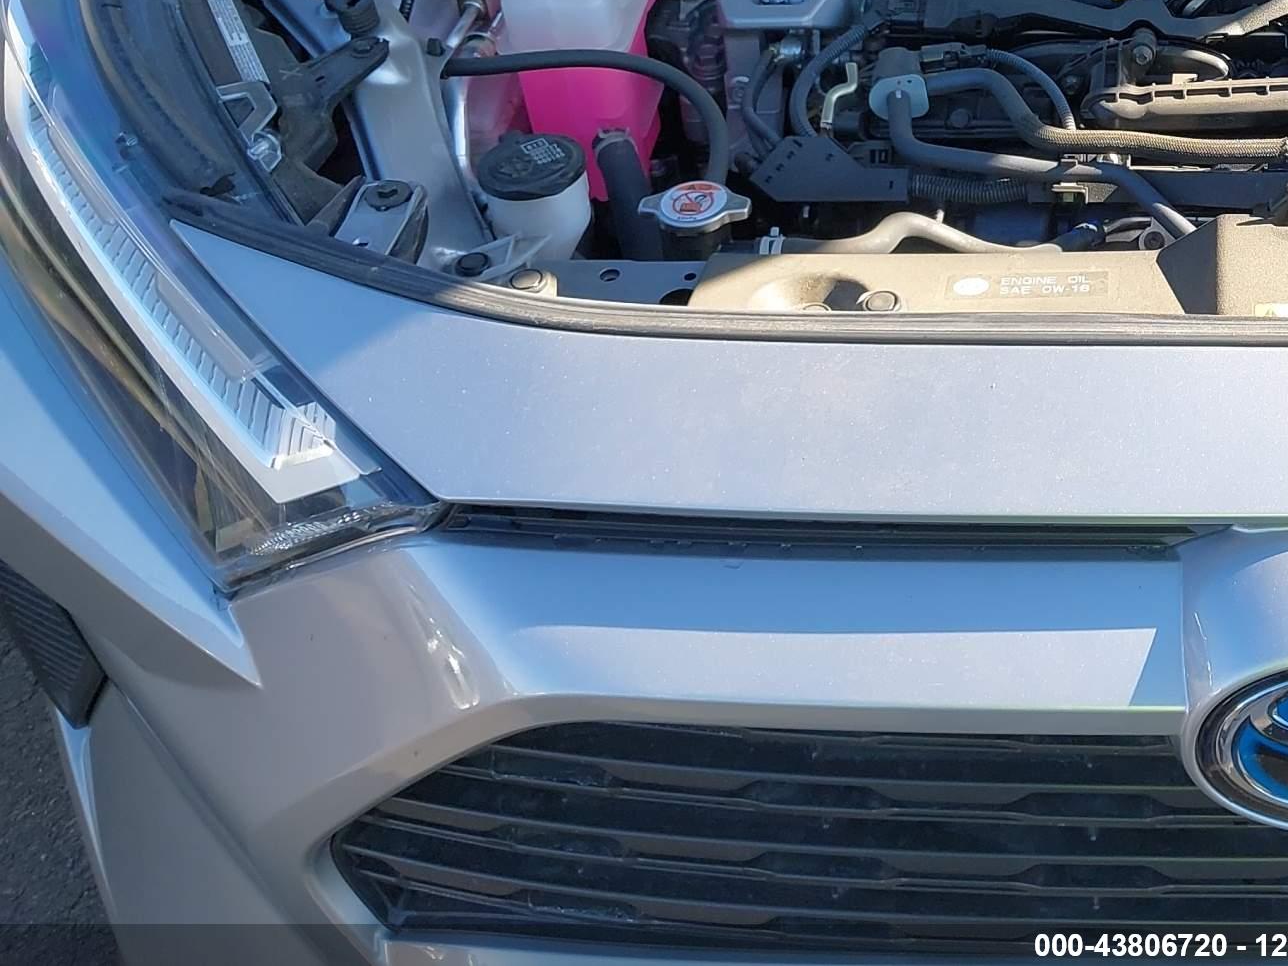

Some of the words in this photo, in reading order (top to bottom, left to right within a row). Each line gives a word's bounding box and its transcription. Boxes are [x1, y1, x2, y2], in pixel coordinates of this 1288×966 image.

[1001, 276, 1057, 284] ENGINE
[1068, 275, 1091, 284] OIL
[999, 285, 1031, 295] SAE
